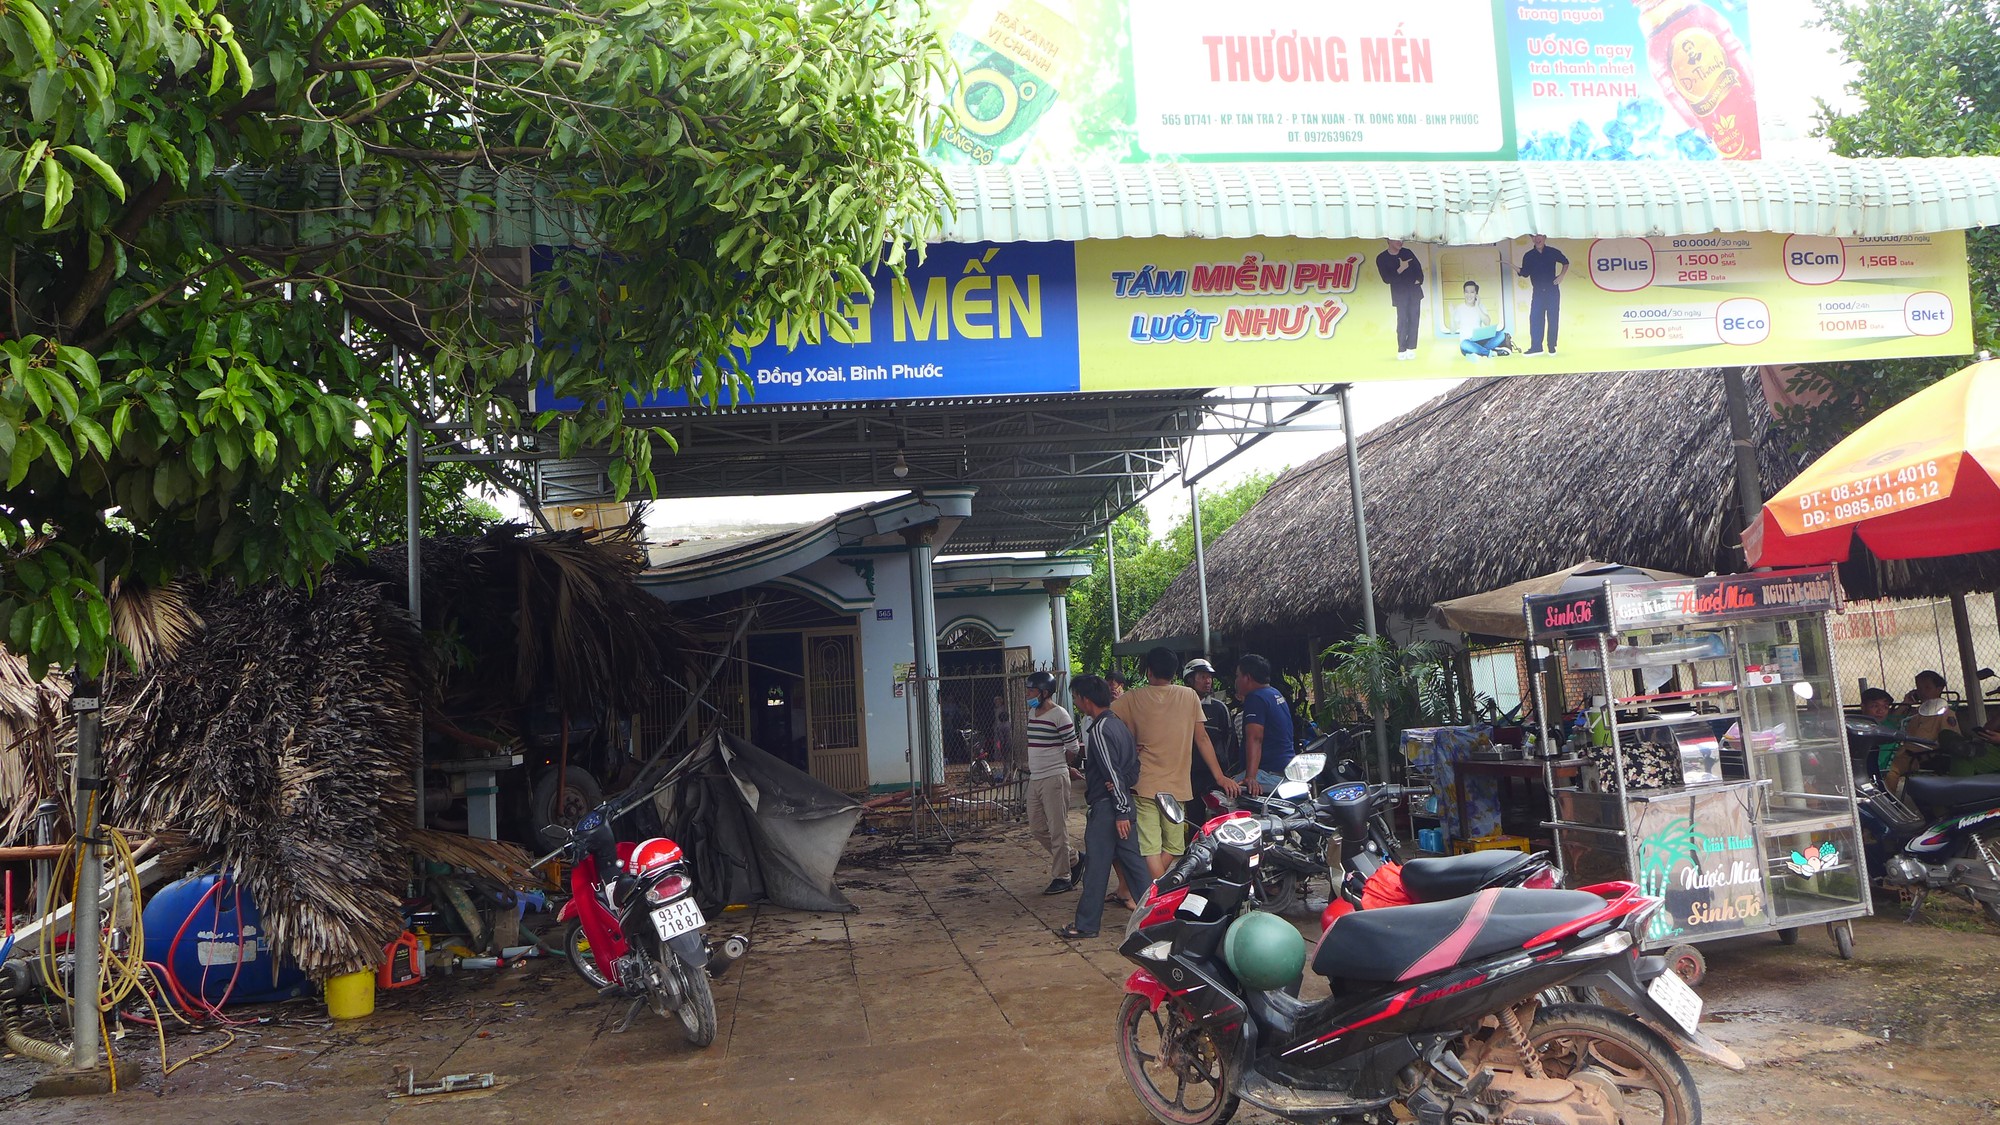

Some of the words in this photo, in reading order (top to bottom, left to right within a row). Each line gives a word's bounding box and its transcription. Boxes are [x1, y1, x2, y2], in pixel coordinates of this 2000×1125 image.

[1519, 8, 1557, 22] trong
[1020, 26, 1060, 57] XANH
[1528, 34, 1588, 54] UỐNG
[1596, 46, 1631, 58] ngay
[1002, 36, 1052, 72] CHANH
[1202, 29, 1350, 83] THƯƠNG
[1362, 22, 1434, 83] MẾN
[1555, 62, 1595, 73] thanh
[1533, 83, 1563, 97] DR.
[1570, 83, 1637, 97] THANH
[1161, 113, 1181, 125] 565
[1277, 114, 1283, 124] 2
[1304, 131, 1363, 142] 0972639629
[1597, 258, 1648, 272] 8Plus
[1676, 254, 1719, 266] 1.500
[1791, 252, 1839, 266] 8Com
[1859, 255, 1897, 268] 1,5GB
[1111, 264, 1186, 297] TÁM
[1191, 255, 1288, 294] MIỄN
[1293, 256, 1364, 293] PHÍ
[1678, 271, 1708, 281] 2GB
[892, 248, 1042, 342] MẾN
[1130, 308, 1220, 341] LƯỚT
[1224, 305, 1308, 338] NHƯ
[1313, 300, 1343, 339] Ý
[1723, 317, 1765, 330] 8Eco
[1911, 309, 1944, 321] 8Net
[1623, 327, 1665, 339] 1.500
[1819, 320, 1867, 331] 100MB
[757, 366, 802, 386] Đồng
[805, 367, 846, 382] Xoài,
[850, 365, 887, 381] Bình
[892, 363, 943, 379] Phước
[1800, 491, 1827, 510] ĐT:
[1830, 460, 1938, 502] 08.3711.4016
[1803, 510, 1830, 528] DĐ:
[1834, 481, 1939, 520] 0985.60.16.12
[1722, 585, 1757, 610] Mía
[1762, 577, 1802, 604] NGUYÊN
[878, 610, 891, 618] 565
[1544, 603, 1576, 628] Sinh
[1573, 600, 1595, 622] Tố
[1681, 864, 1726, 890] Nước
[1724, 861, 1762, 885] Mía
[658, 901, 691, 922] 93-P1
[1688, 900, 1736, 925] Sinh
[1735, 892, 1763, 918] Tố
